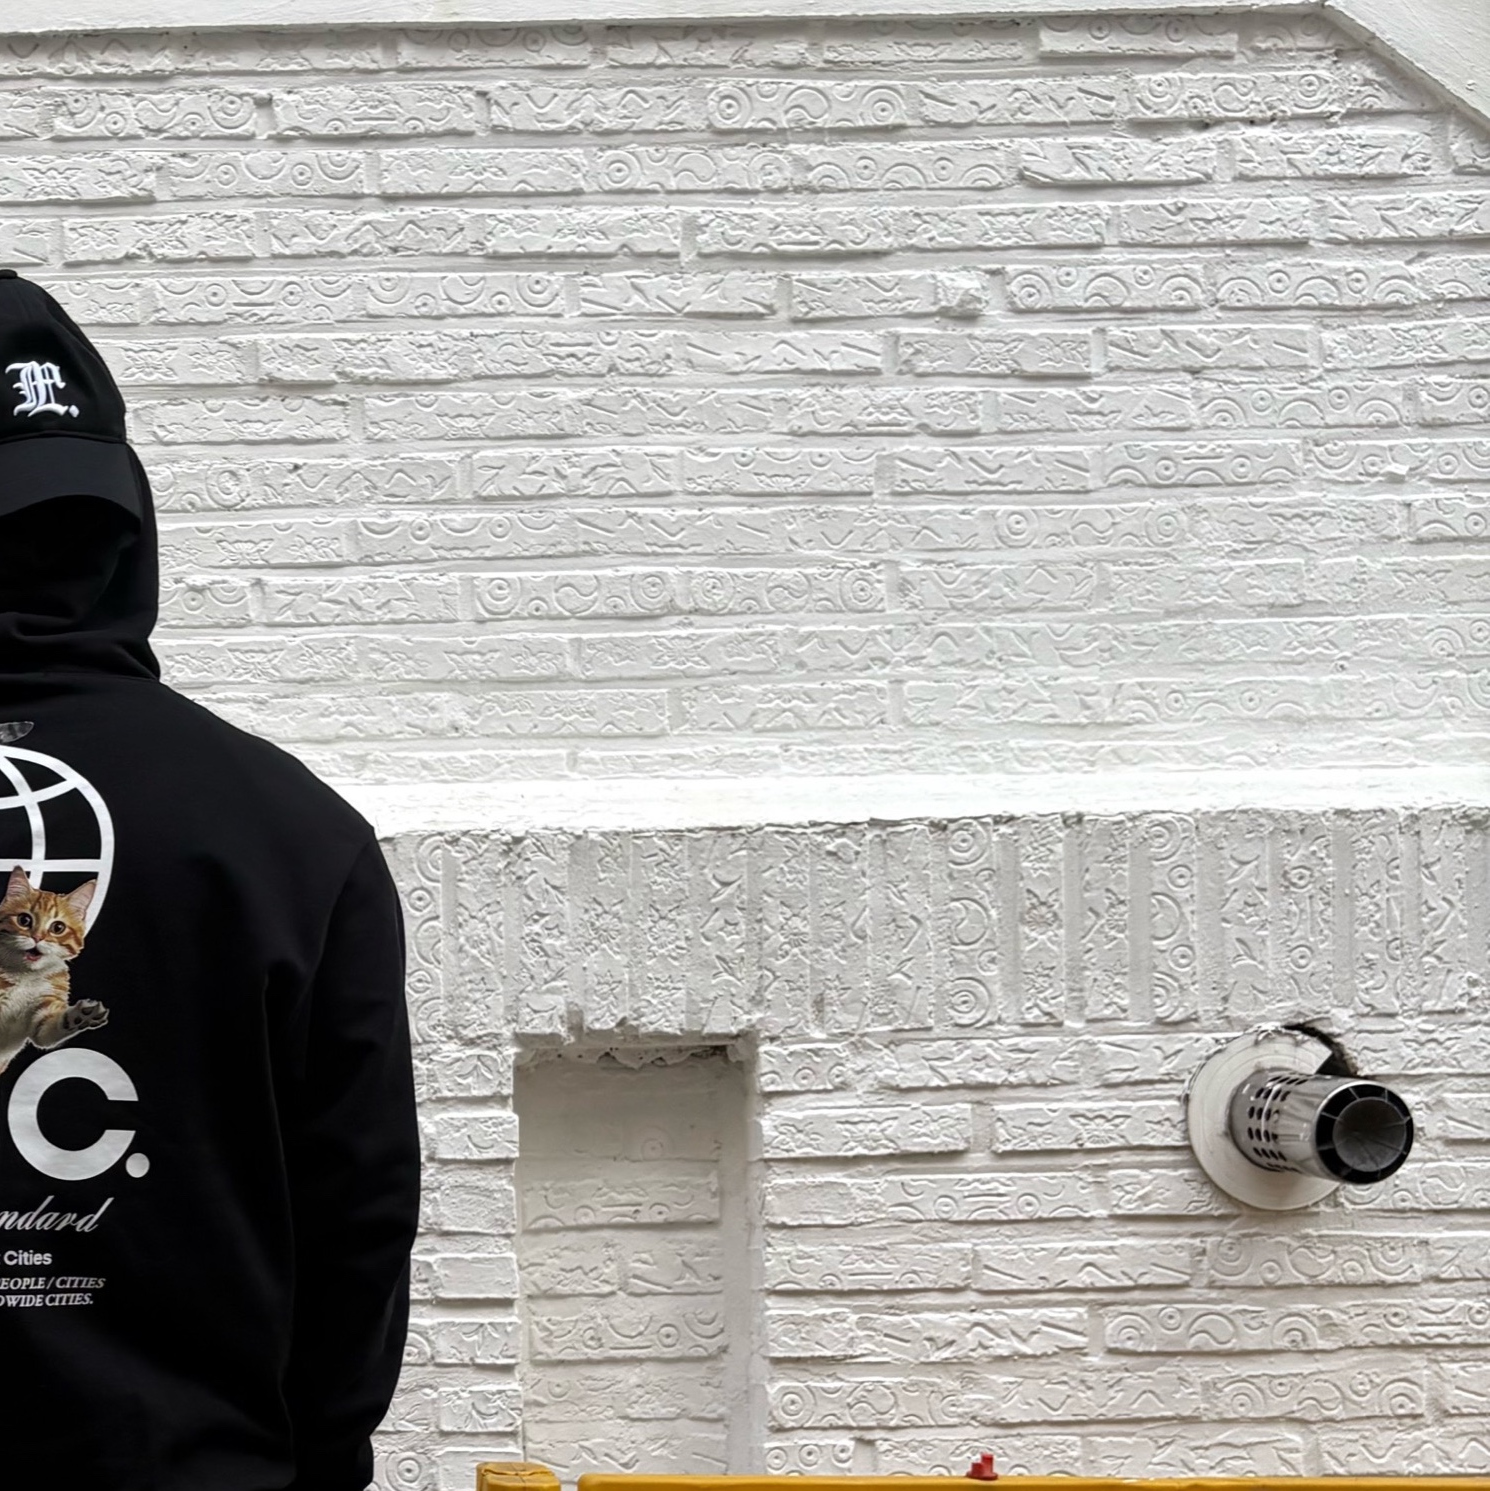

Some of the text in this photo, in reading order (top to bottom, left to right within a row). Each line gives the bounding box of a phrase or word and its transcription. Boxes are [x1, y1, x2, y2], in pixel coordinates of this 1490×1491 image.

[3, 1249, 53, 1266] Cities
[55, 1276, 107, 1289] CITIES
[44, 1292, 94, 1306] CITIES.
